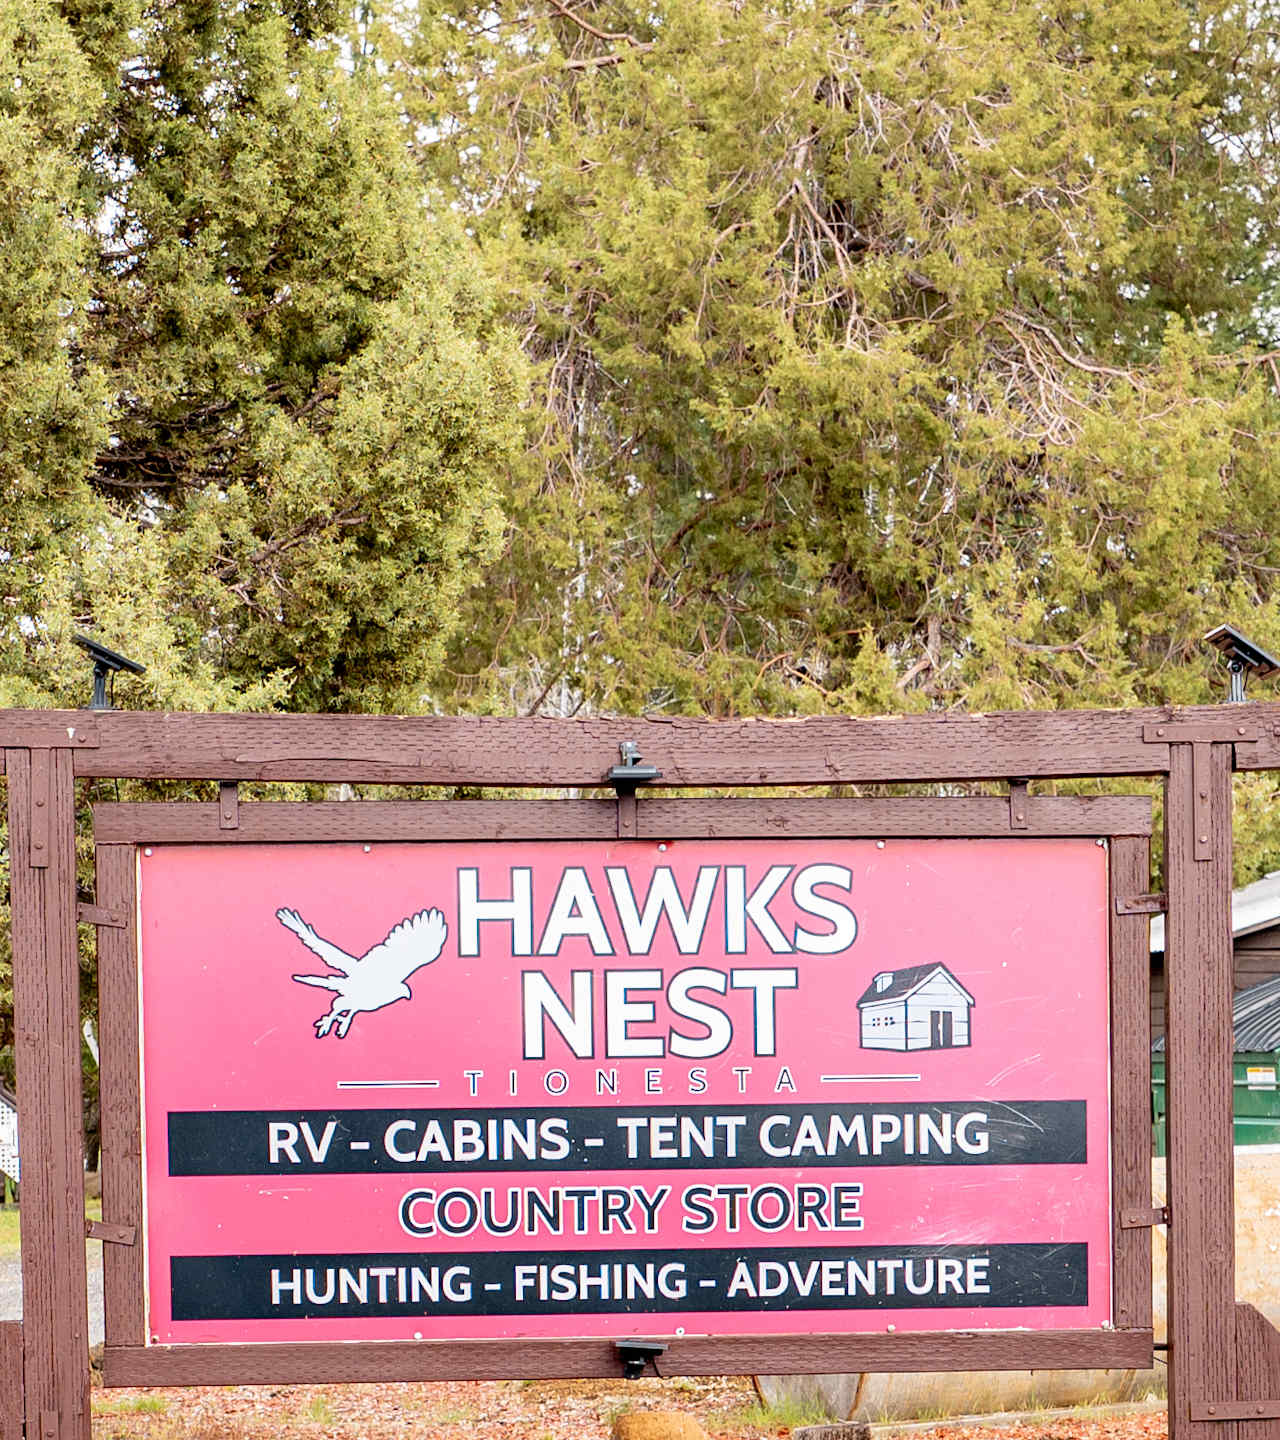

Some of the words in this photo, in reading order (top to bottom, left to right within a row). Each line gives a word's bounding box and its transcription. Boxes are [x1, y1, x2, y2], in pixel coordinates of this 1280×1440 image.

[455, 862, 859, 958] HAWKS
[522, 967, 799, 1060] NEST
[465, 1065, 797, 1097] TIONESTA
[268, 1120, 338, 1164] RV
[384, 1116, 571, 1161] CABINS
[617, 1114, 747, 1157] TENT
[759, 1110, 990, 1156] CAMPING
[399, 1186, 672, 1237] COUNTRY
[681, 1181, 864, 1232] STORE
[271, 1265, 472, 1306] HUNTING
[515, 1262, 686, 1302] FISHING
[727, 1257, 990, 1297] ADVENTURE
